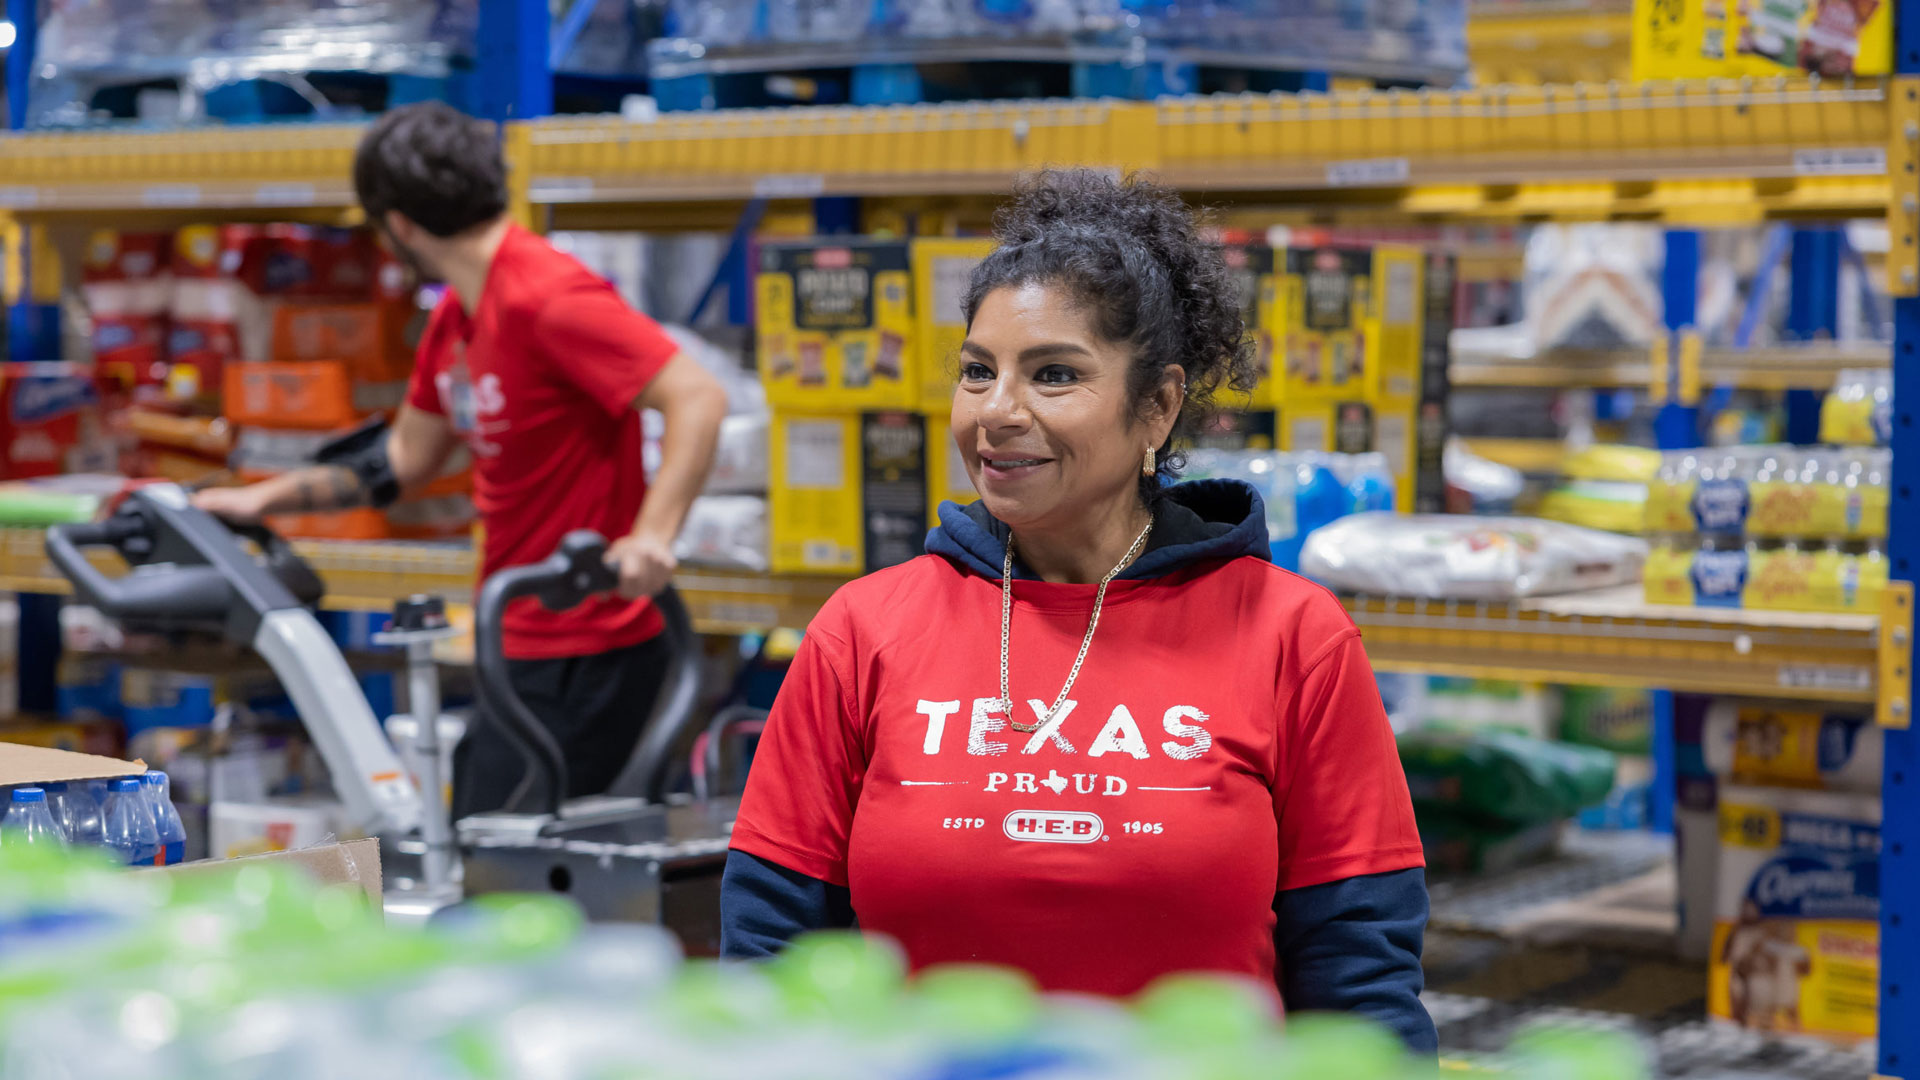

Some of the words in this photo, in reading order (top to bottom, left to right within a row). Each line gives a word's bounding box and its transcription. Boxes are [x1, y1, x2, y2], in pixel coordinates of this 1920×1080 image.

[916, 697, 1212, 760] TEXAS
[943, 817, 986, 830] ESTD
[1017, 818, 1094, 836] H-E-B
[1123, 821, 1165, 836] 1905
